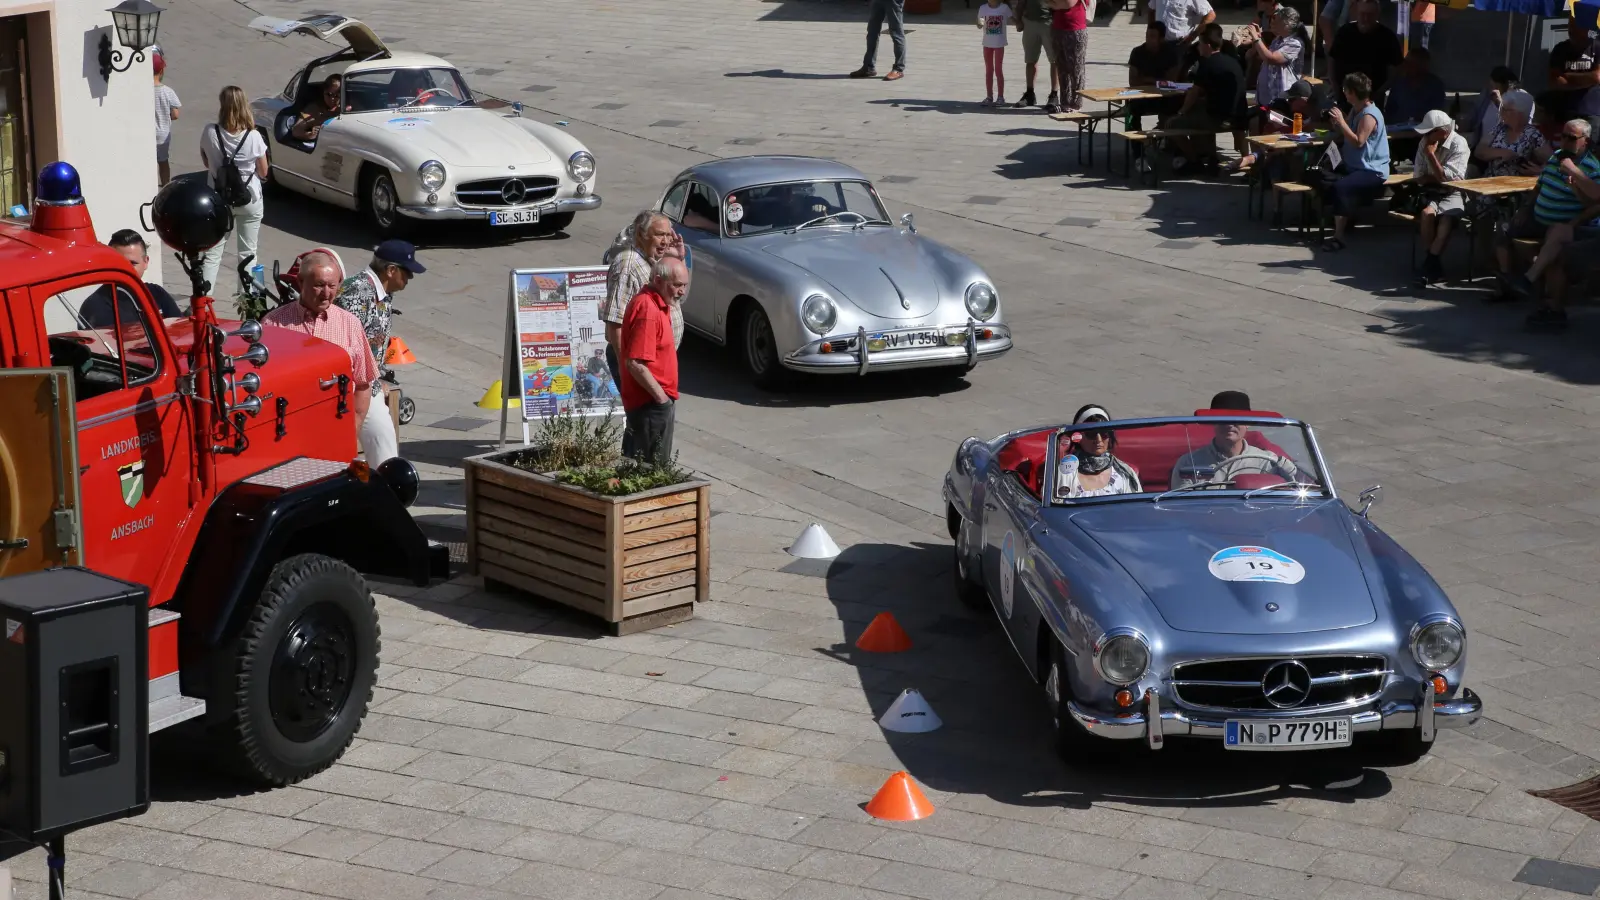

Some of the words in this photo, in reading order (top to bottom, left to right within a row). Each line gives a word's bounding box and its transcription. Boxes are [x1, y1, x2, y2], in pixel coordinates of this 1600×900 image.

[1565, 61, 1591, 70] PUMA
[497, 212, 507, 224] SC
[571, 274, 607, 284] Sommerkin
[521, 347, 539, 357] 36.
[101, 431, 157, 460] LANDKREIS
[110, 514, 155, 541] ANSBACH
[1245, 561, 1273, 570] 19
[1240, 724, 1253, 743] N
[1268, 724, 1280, 743] P
[1285, 722, 1337, 743] 779H
